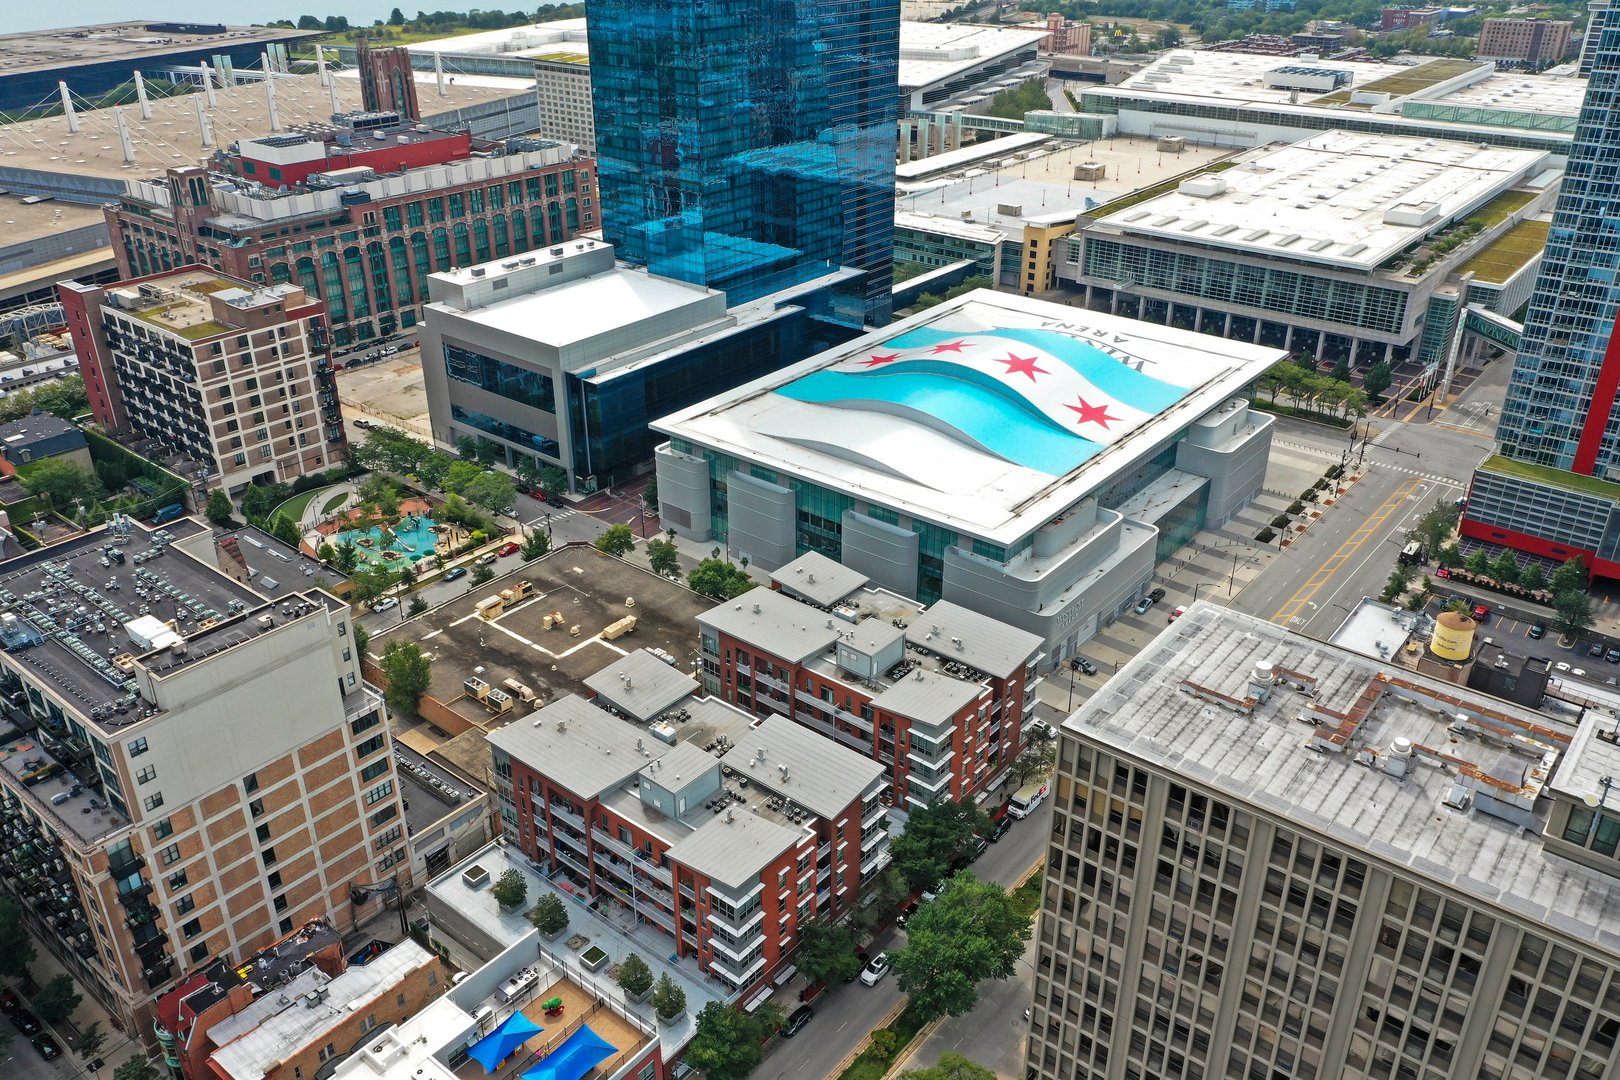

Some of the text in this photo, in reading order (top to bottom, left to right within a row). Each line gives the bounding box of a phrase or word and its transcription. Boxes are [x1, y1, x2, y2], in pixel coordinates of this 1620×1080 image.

[1041, 321, 1128, 343] ARENA
[1290, 615, 1307, 625] ONLY
[1031, 785, 1047, 804] FedEx
